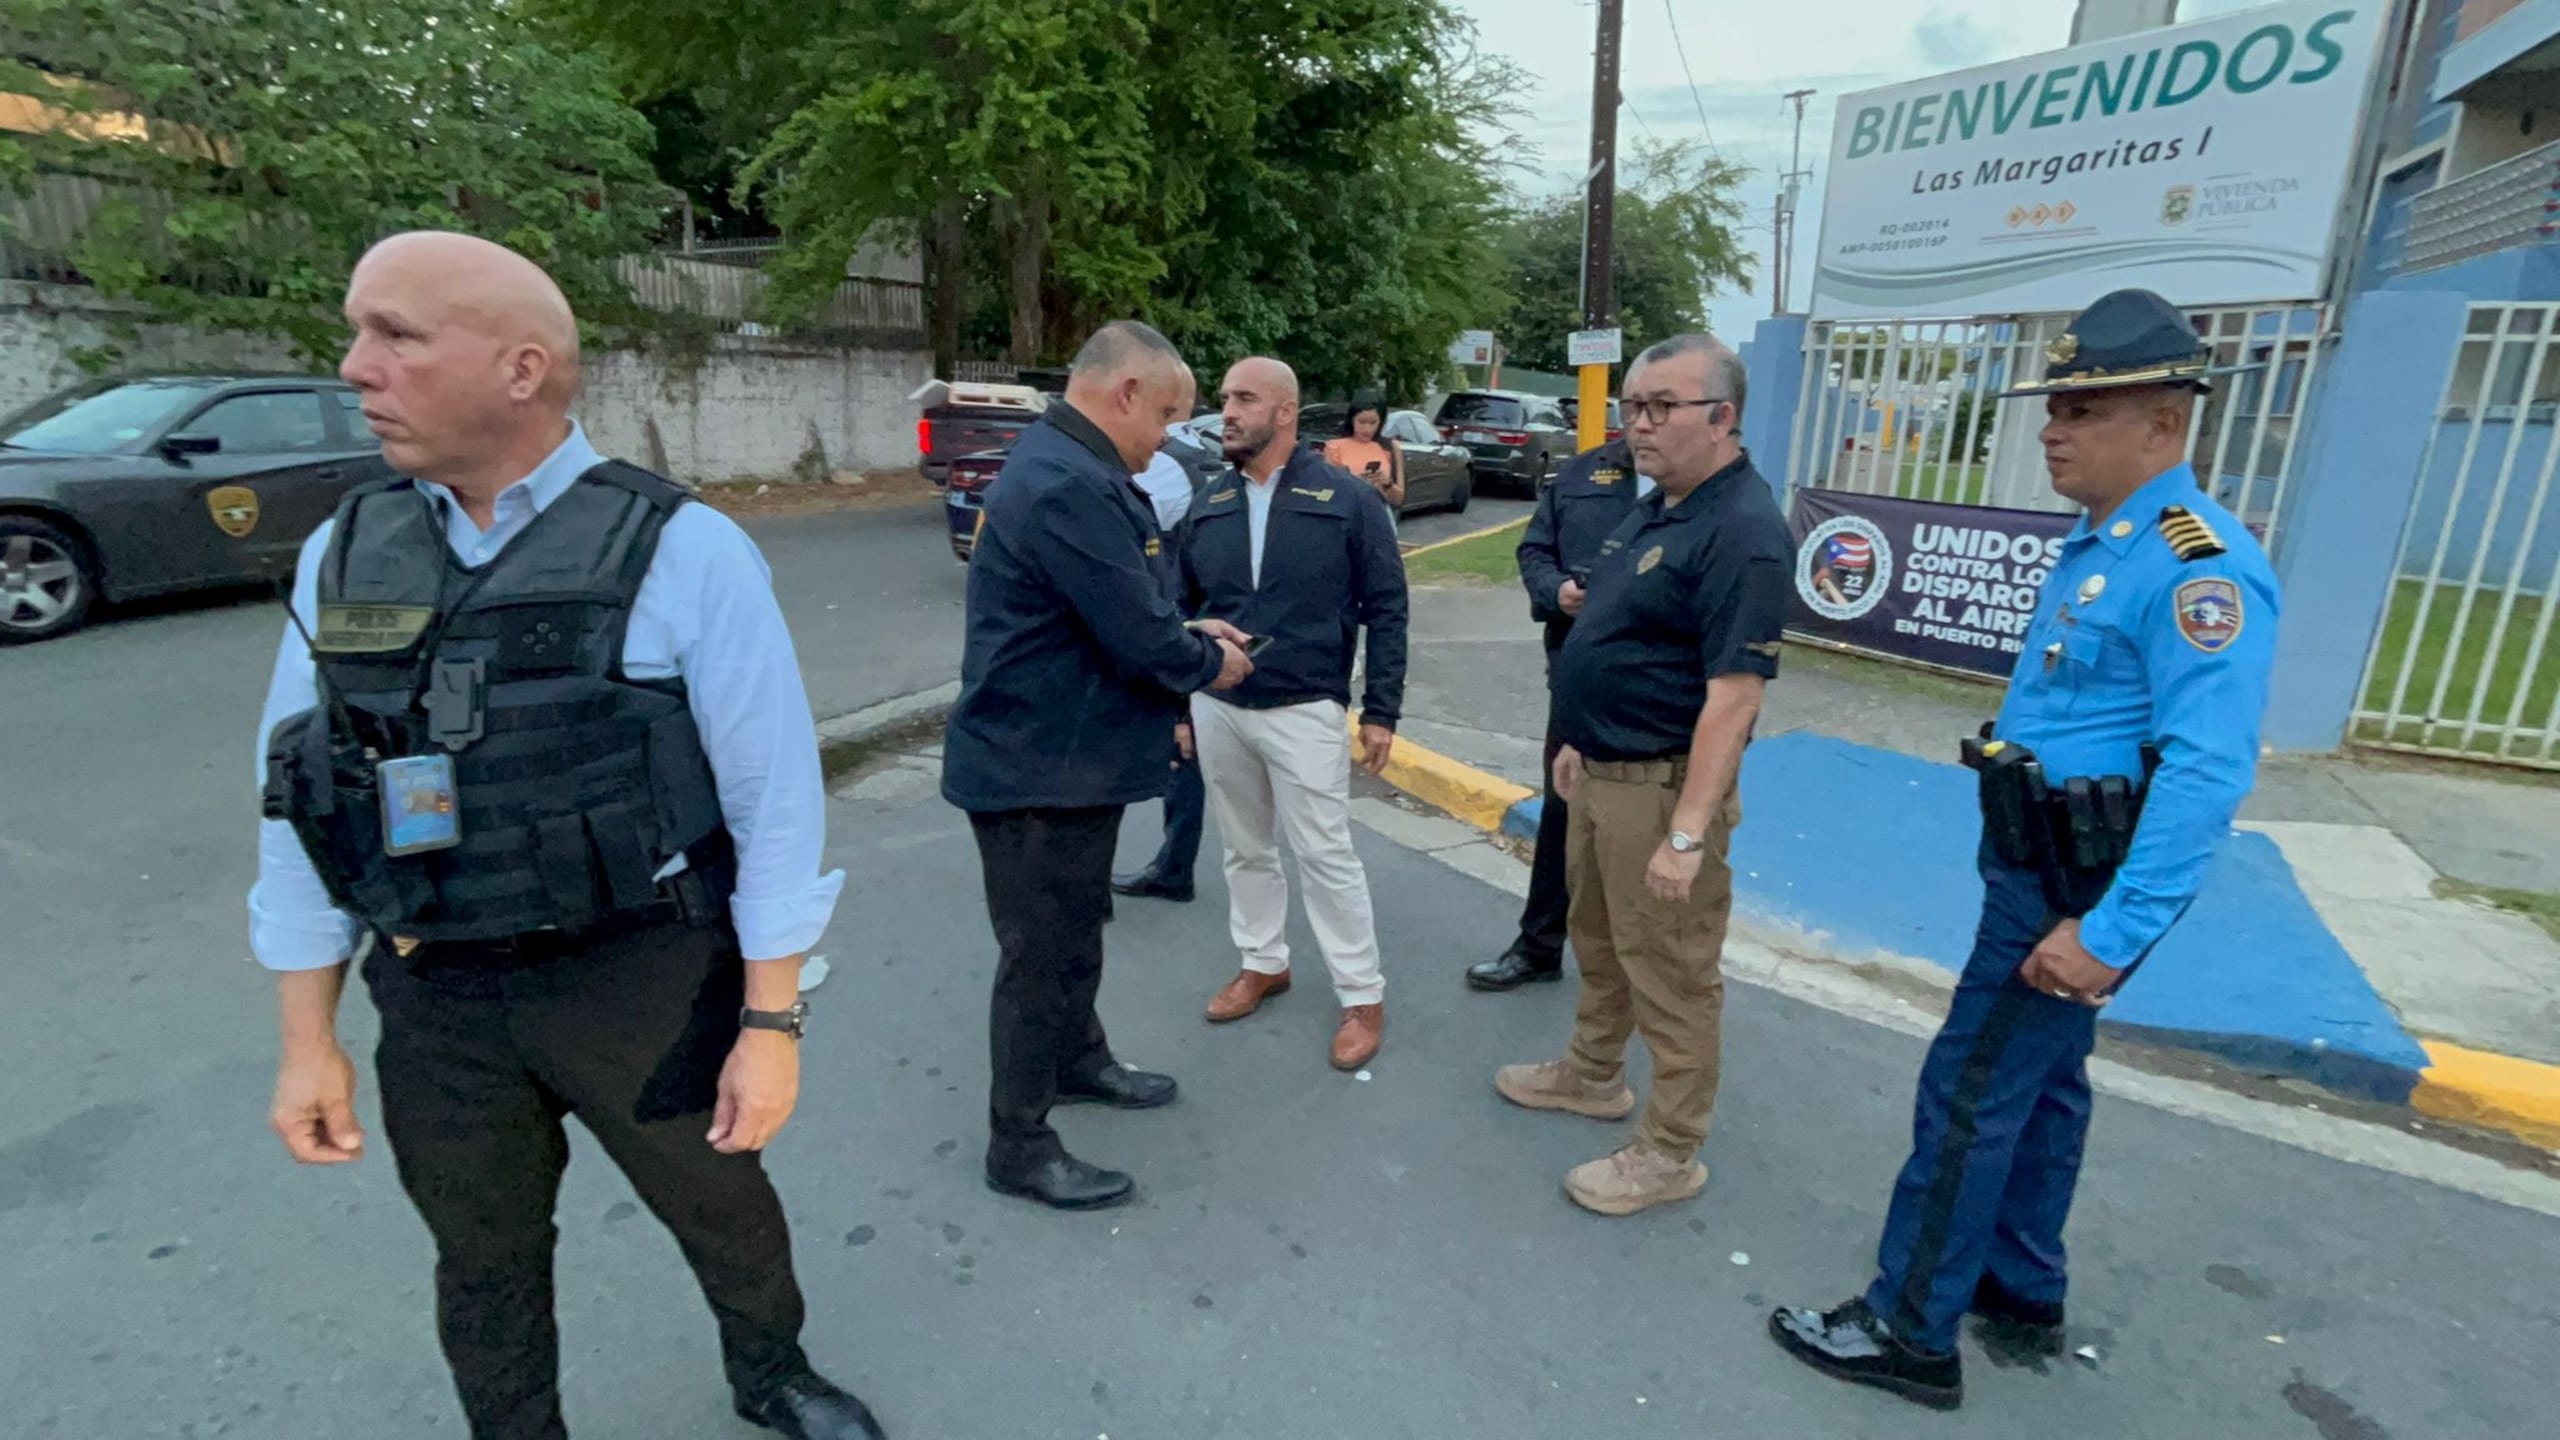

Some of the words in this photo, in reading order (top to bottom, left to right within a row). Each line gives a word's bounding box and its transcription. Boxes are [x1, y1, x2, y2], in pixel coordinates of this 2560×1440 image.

[1846, 9, 2357, 160] BIENVENIDOS
[1912, 169, 1963, 195] Las
[1974, 137, 2182, 187] Margaritas
[2202, 177, 2299, 201] VIVIENDA
[1912, 523, 2065, 567] UNIDOS
[1844, 574, 1864, 588] 22
[1907, 552, 2006, 582] CONTRA
[2012, 565, 2048, 587] LO
[1902, 571, 2036, 611] DISPARO
[1912, 598, 1953, 623] AL
[1895, 619, 1919, 635] EN
[1922, 623, 1997, 649] PUERTO
[2000, 637, 2025, 653] RI
